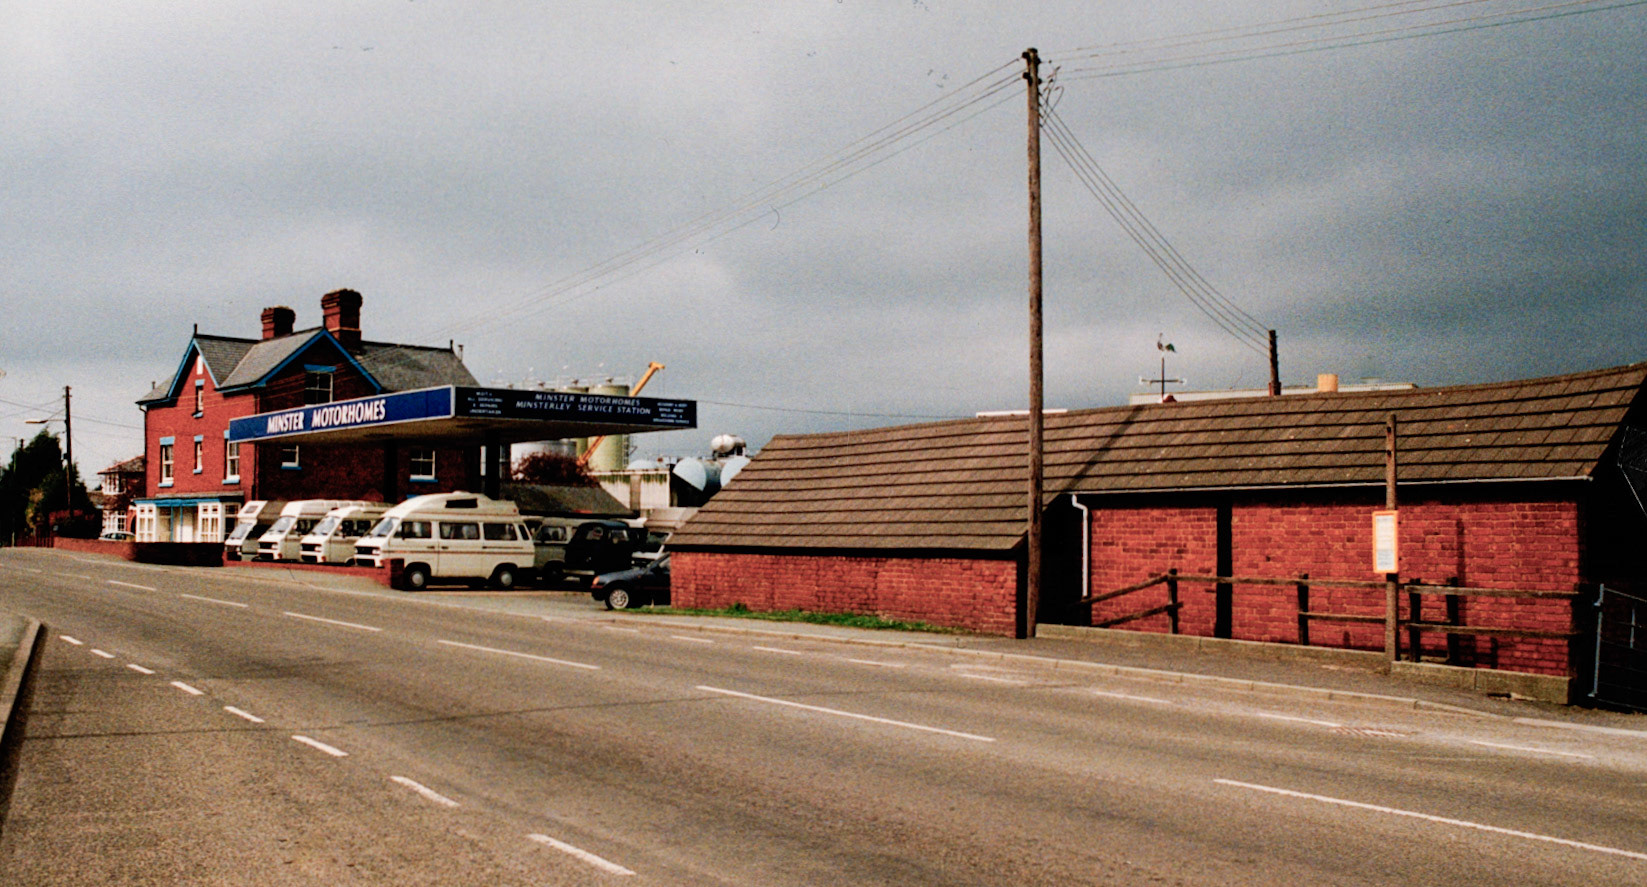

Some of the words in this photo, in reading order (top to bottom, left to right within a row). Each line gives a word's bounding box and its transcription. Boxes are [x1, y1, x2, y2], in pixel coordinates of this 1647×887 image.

[535, 393, 575, 402] MINSTER
[580, 396, 640, 406] MOTORHOMES
[515, 401, 571, 411] MINSTERLEY
[578, 404, 613, 412] SERVICE
[617, 406, 651, 415] STATION
[267, 411, 305, 434] MINSTER
[311, 399, 386, 428] MOTORHOMES
